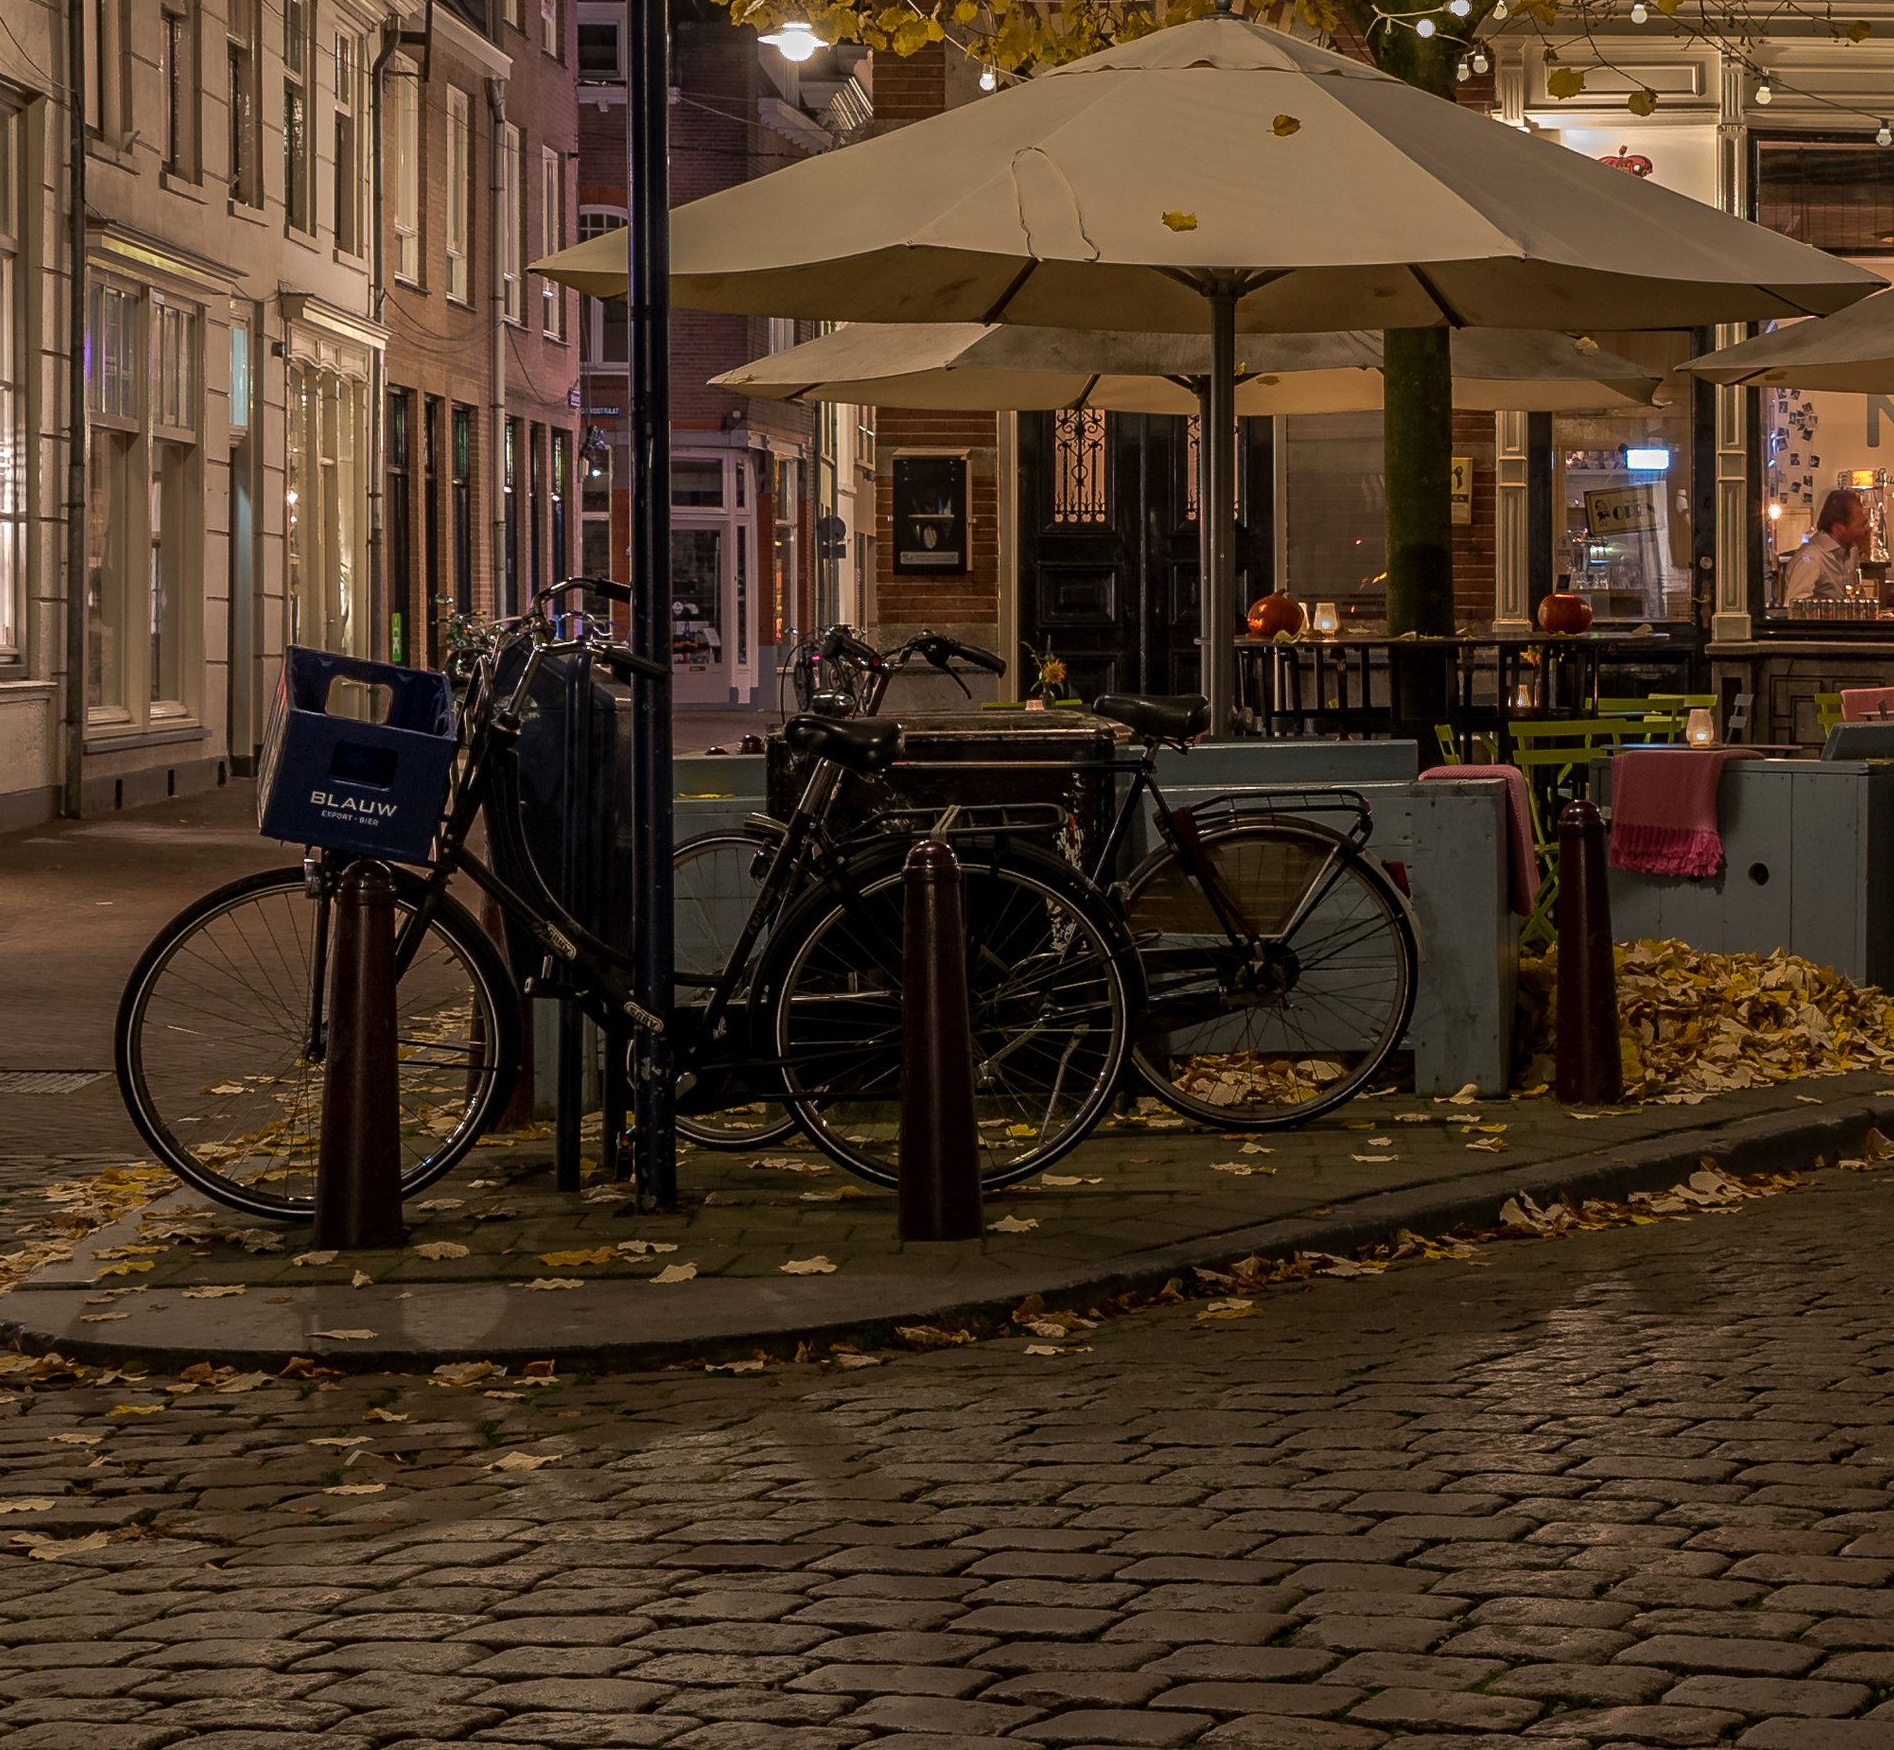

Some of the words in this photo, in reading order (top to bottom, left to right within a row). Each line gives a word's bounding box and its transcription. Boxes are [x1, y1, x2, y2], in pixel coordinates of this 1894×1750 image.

[310, 790, 398, 818] BLAUW
[321, 809, 353, 822] EXPORT
[359, 814, 379, 827] BIER
